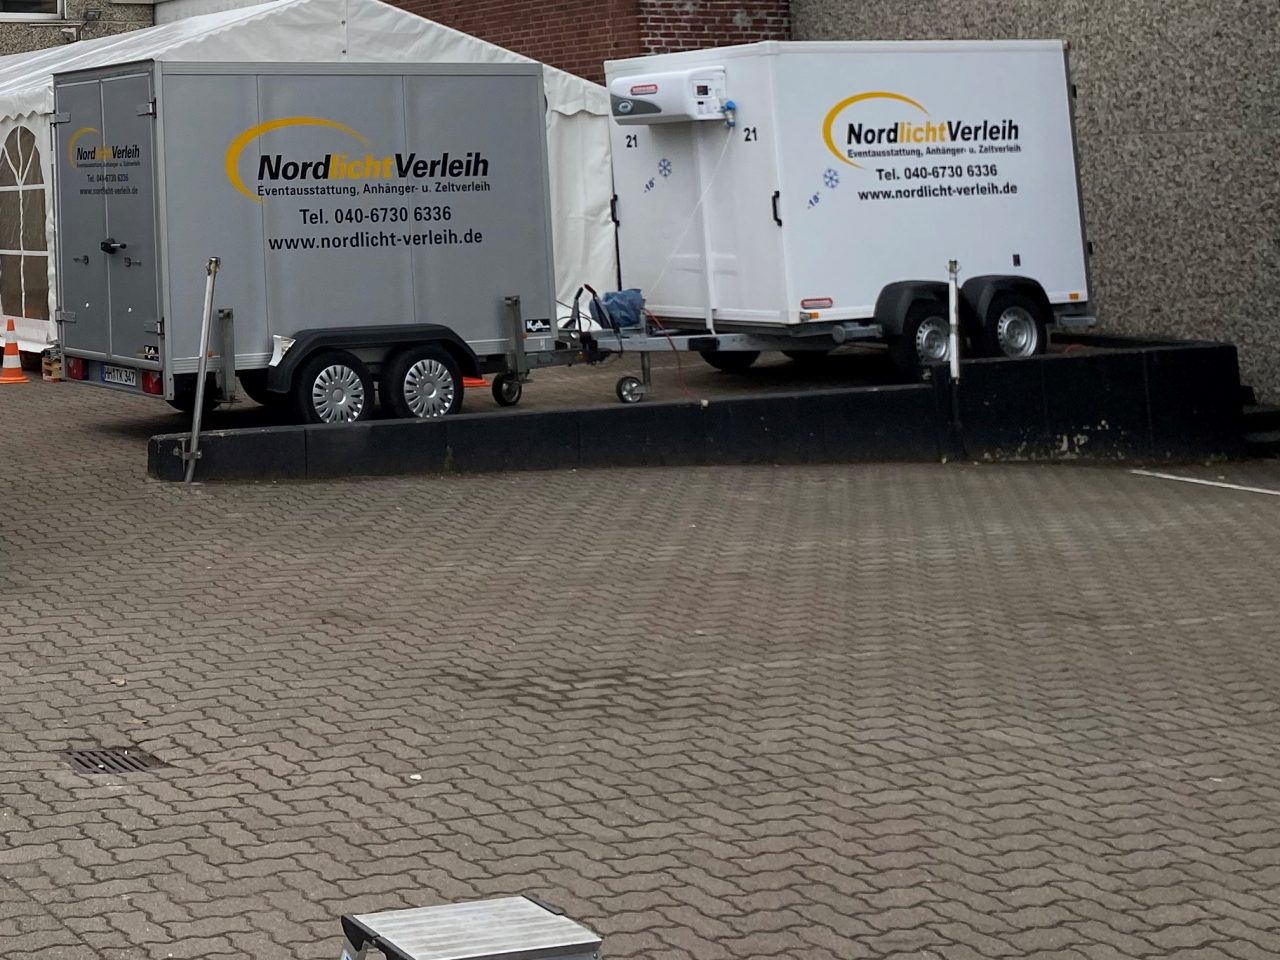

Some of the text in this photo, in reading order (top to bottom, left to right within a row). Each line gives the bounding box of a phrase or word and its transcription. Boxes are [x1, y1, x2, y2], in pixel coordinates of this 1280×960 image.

[743, 127, 757, 142] 21
[847, 119, 1019, 145] NordlichtVerleih
[626, 134, 638, 148] 21
[76, 144, 140, 161] NordVerleih
[847, 148, 924, 158] Eventausstattung,
[925, 146, 967, 156] Anhänger-
[978, 144, 1022, 154] Zeltverleih
[257, 152, 489, 181] NordlichtVerleih
[876, 164, 998, 181] Tel. 040-6730 6336
[257, 181, 490, 197] Eventausstattung, Anhänger- u. Zeltverleih
[858, 182, 1018, 201] www.nordlicht-verleih.de
[299, 205, 452, 225] Tel. 040-6730 6336
[268, 228, 483, 250] www.nordlicht-verleih.de
